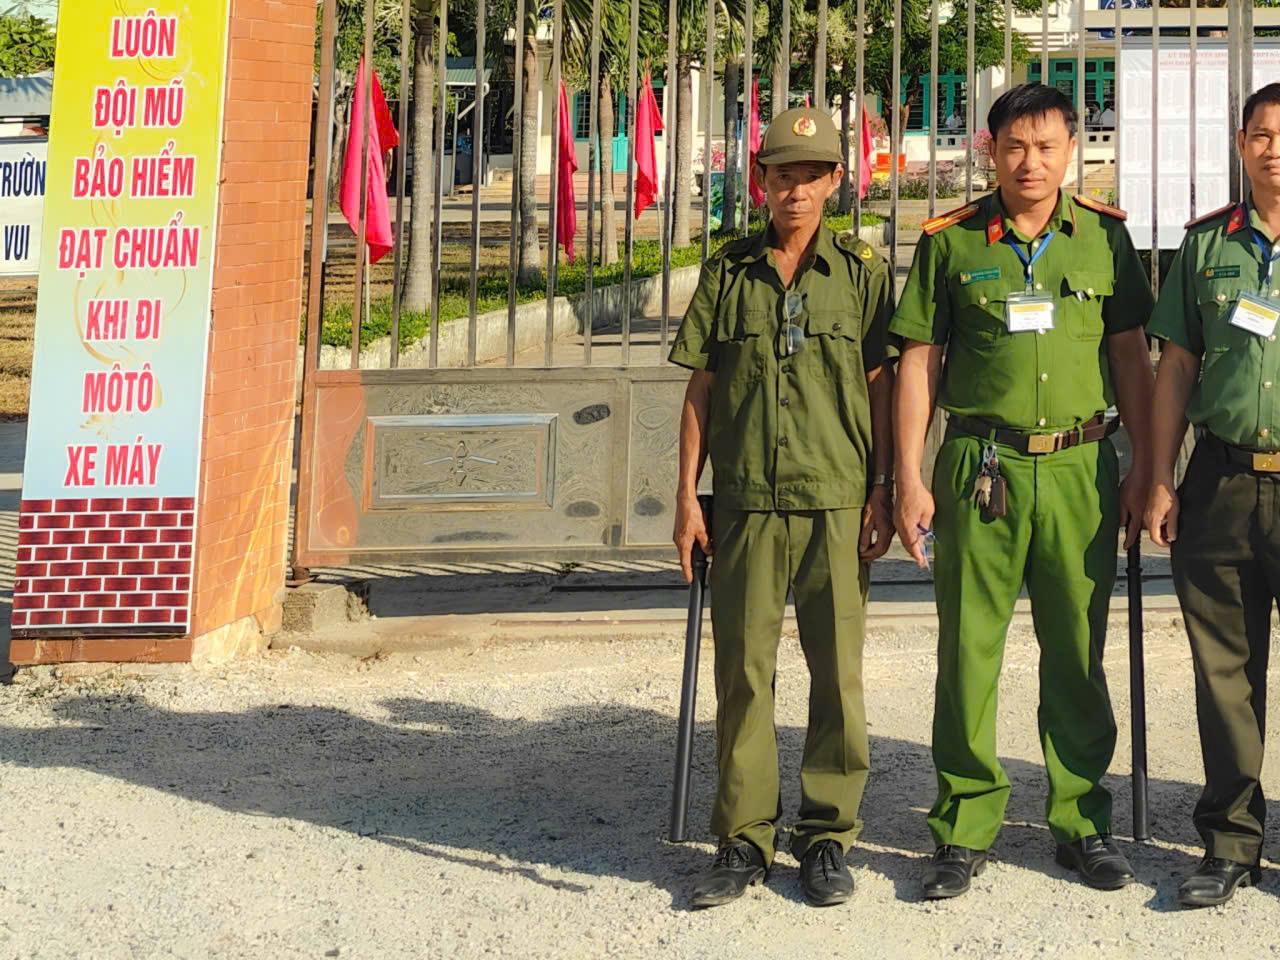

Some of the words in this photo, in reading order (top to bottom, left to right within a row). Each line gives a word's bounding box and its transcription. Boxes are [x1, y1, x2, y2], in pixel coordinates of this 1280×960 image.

[111, 11, 177, 58] LUÔN
[94, 80, 136, 136] ĐỘI
[143, 78, 184, 127] MŨ
[0, 152, 46, 197] RƯỜN
[73, 144, 124, 198] BẢO
[130, 141, 195, 197] HIỂM
[4, 225, 30, 261] VUI
[58, 227, 106, 279] ĐẠT
[113, 211, 200, 269] CHUẨN
[85, 299, 129, 341] KHI
[135, 299, 162, 340] ĐI
[82, 362, 153, 414] MÔTÔ
[64, 445, 97, 486] XE
[104, 435, 163, 486] MÁY
